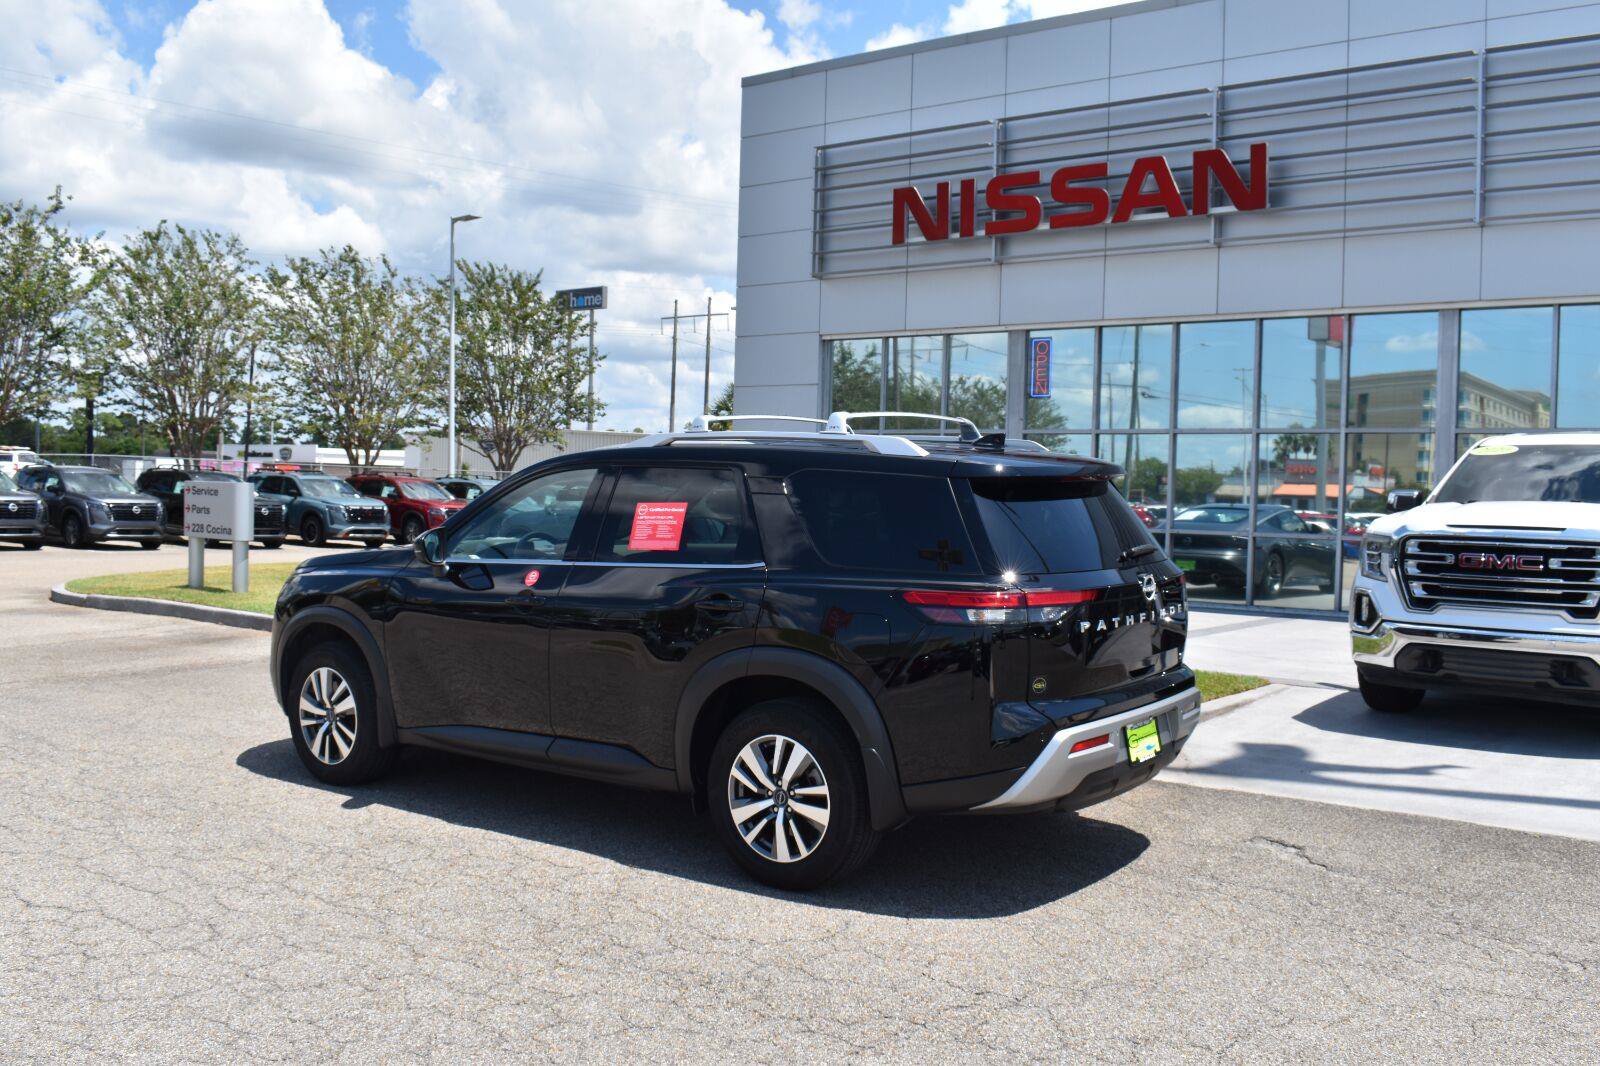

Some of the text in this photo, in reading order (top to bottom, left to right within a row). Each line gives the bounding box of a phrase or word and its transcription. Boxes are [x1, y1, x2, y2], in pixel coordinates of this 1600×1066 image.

[891, 142, 1270, 245] NISSAN
[1035, 341, 1049, 394] OPEN
[192, 486, 219, 496] Service
[192, 504, 211, 515] Parts
[192, 523, 232, 535] 228 Cocina
[1459, 552, 1544, 572] GMC
